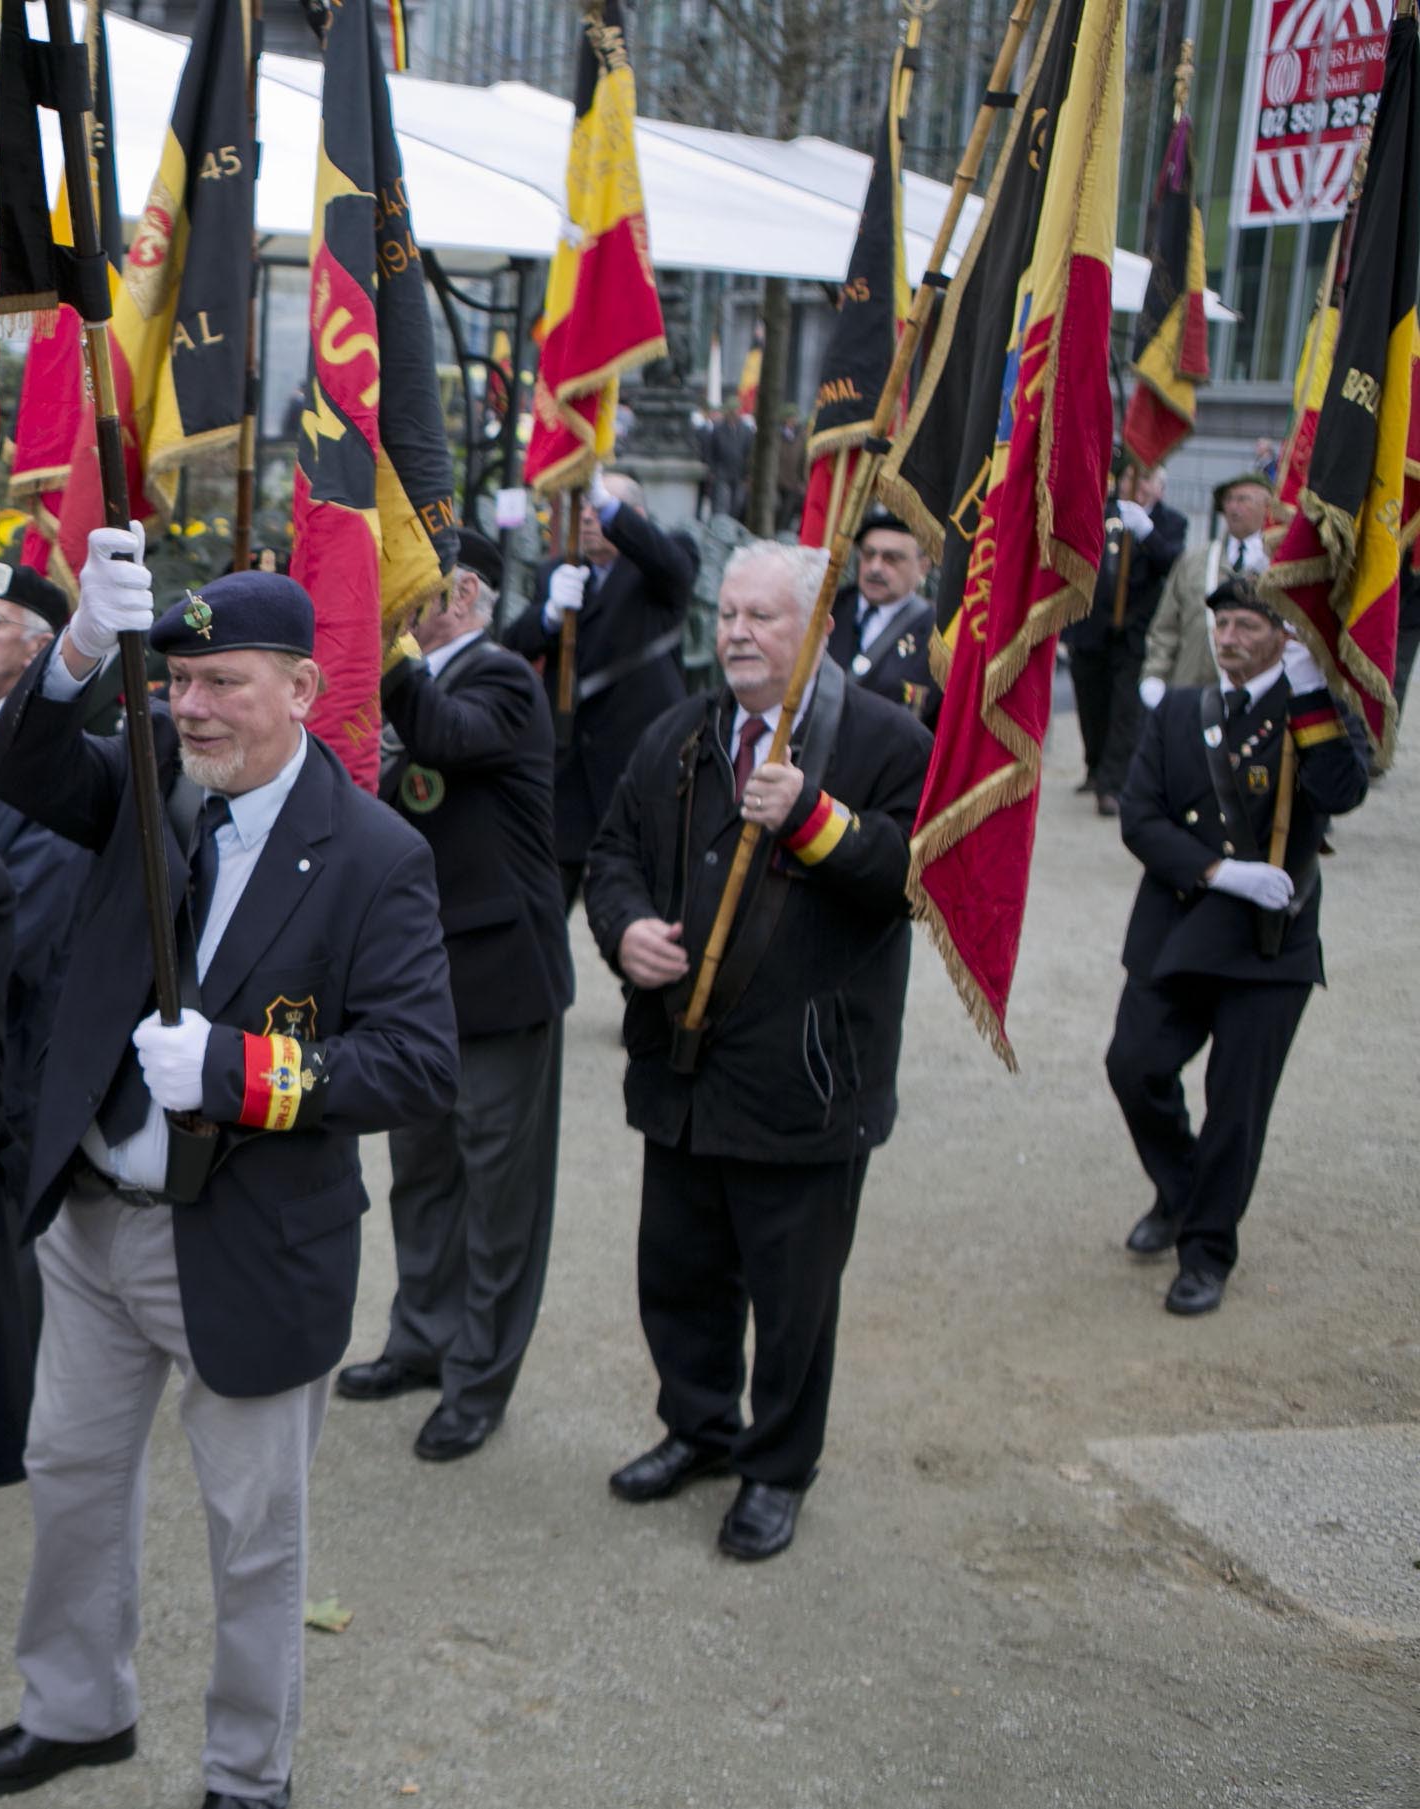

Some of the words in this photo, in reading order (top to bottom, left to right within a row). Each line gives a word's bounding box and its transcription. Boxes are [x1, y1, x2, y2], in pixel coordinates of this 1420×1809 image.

[1260, 107, 1287, 137] 02
[1332, 97, 1359, 127] 25
[1360, 92, 1381, 125] 2
[200, 145, 243, 180] 45
